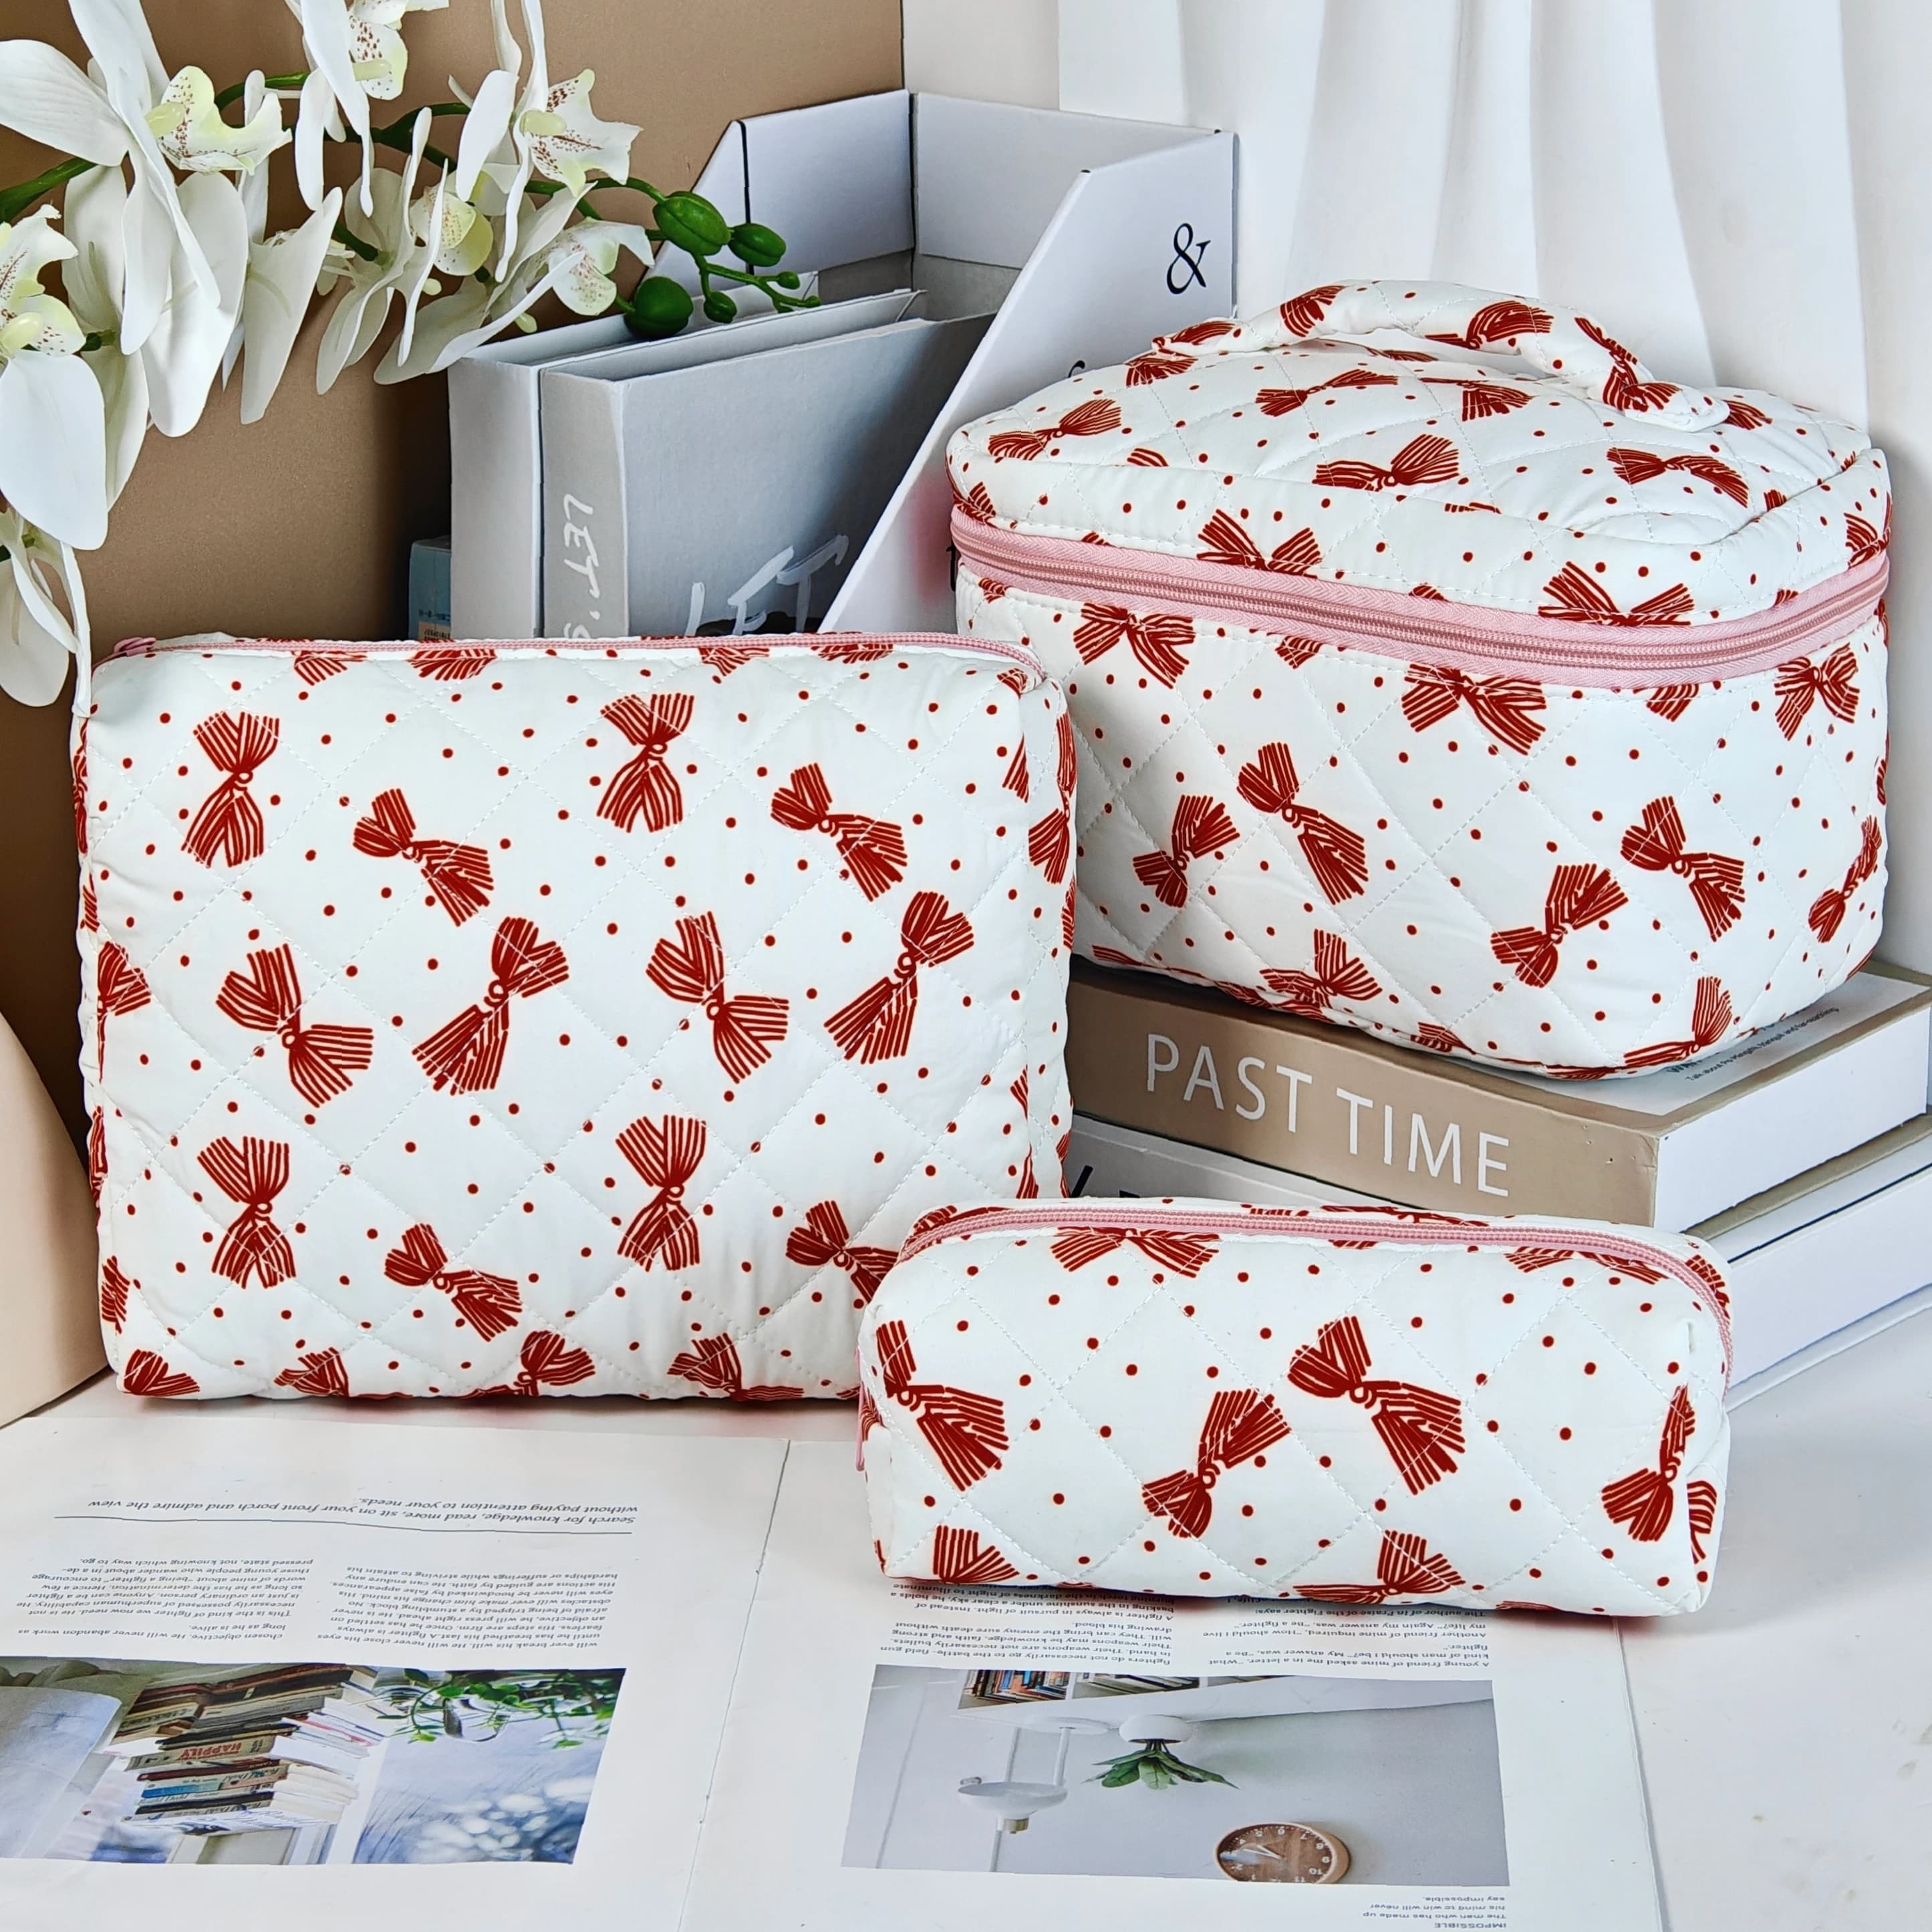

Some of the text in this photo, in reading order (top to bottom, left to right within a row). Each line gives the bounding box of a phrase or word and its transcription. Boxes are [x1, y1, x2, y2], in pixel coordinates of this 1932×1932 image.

[1165, 223, 1212, 295] &
[1146, 1034, 1510, 1198] PAST TIME
[360, 1498, 402, 1506] needs.
[238, 1503, 279, 1511] porch
[282, 1504, 319, 1512] front
[530, 1504, 581, 1512] paying
[583, 1506, 638, 1514] without
[403, 1511, 441, 1519] more,
[482, 1513, 560, 1524] knowledge,
[564, 1516, 585, 1524] for
[1119, 1631, 1145, 1639] They
[1128, 1657, 1170, 1665] fighters
[179, 1743, 242, 1759] HAPPILY
